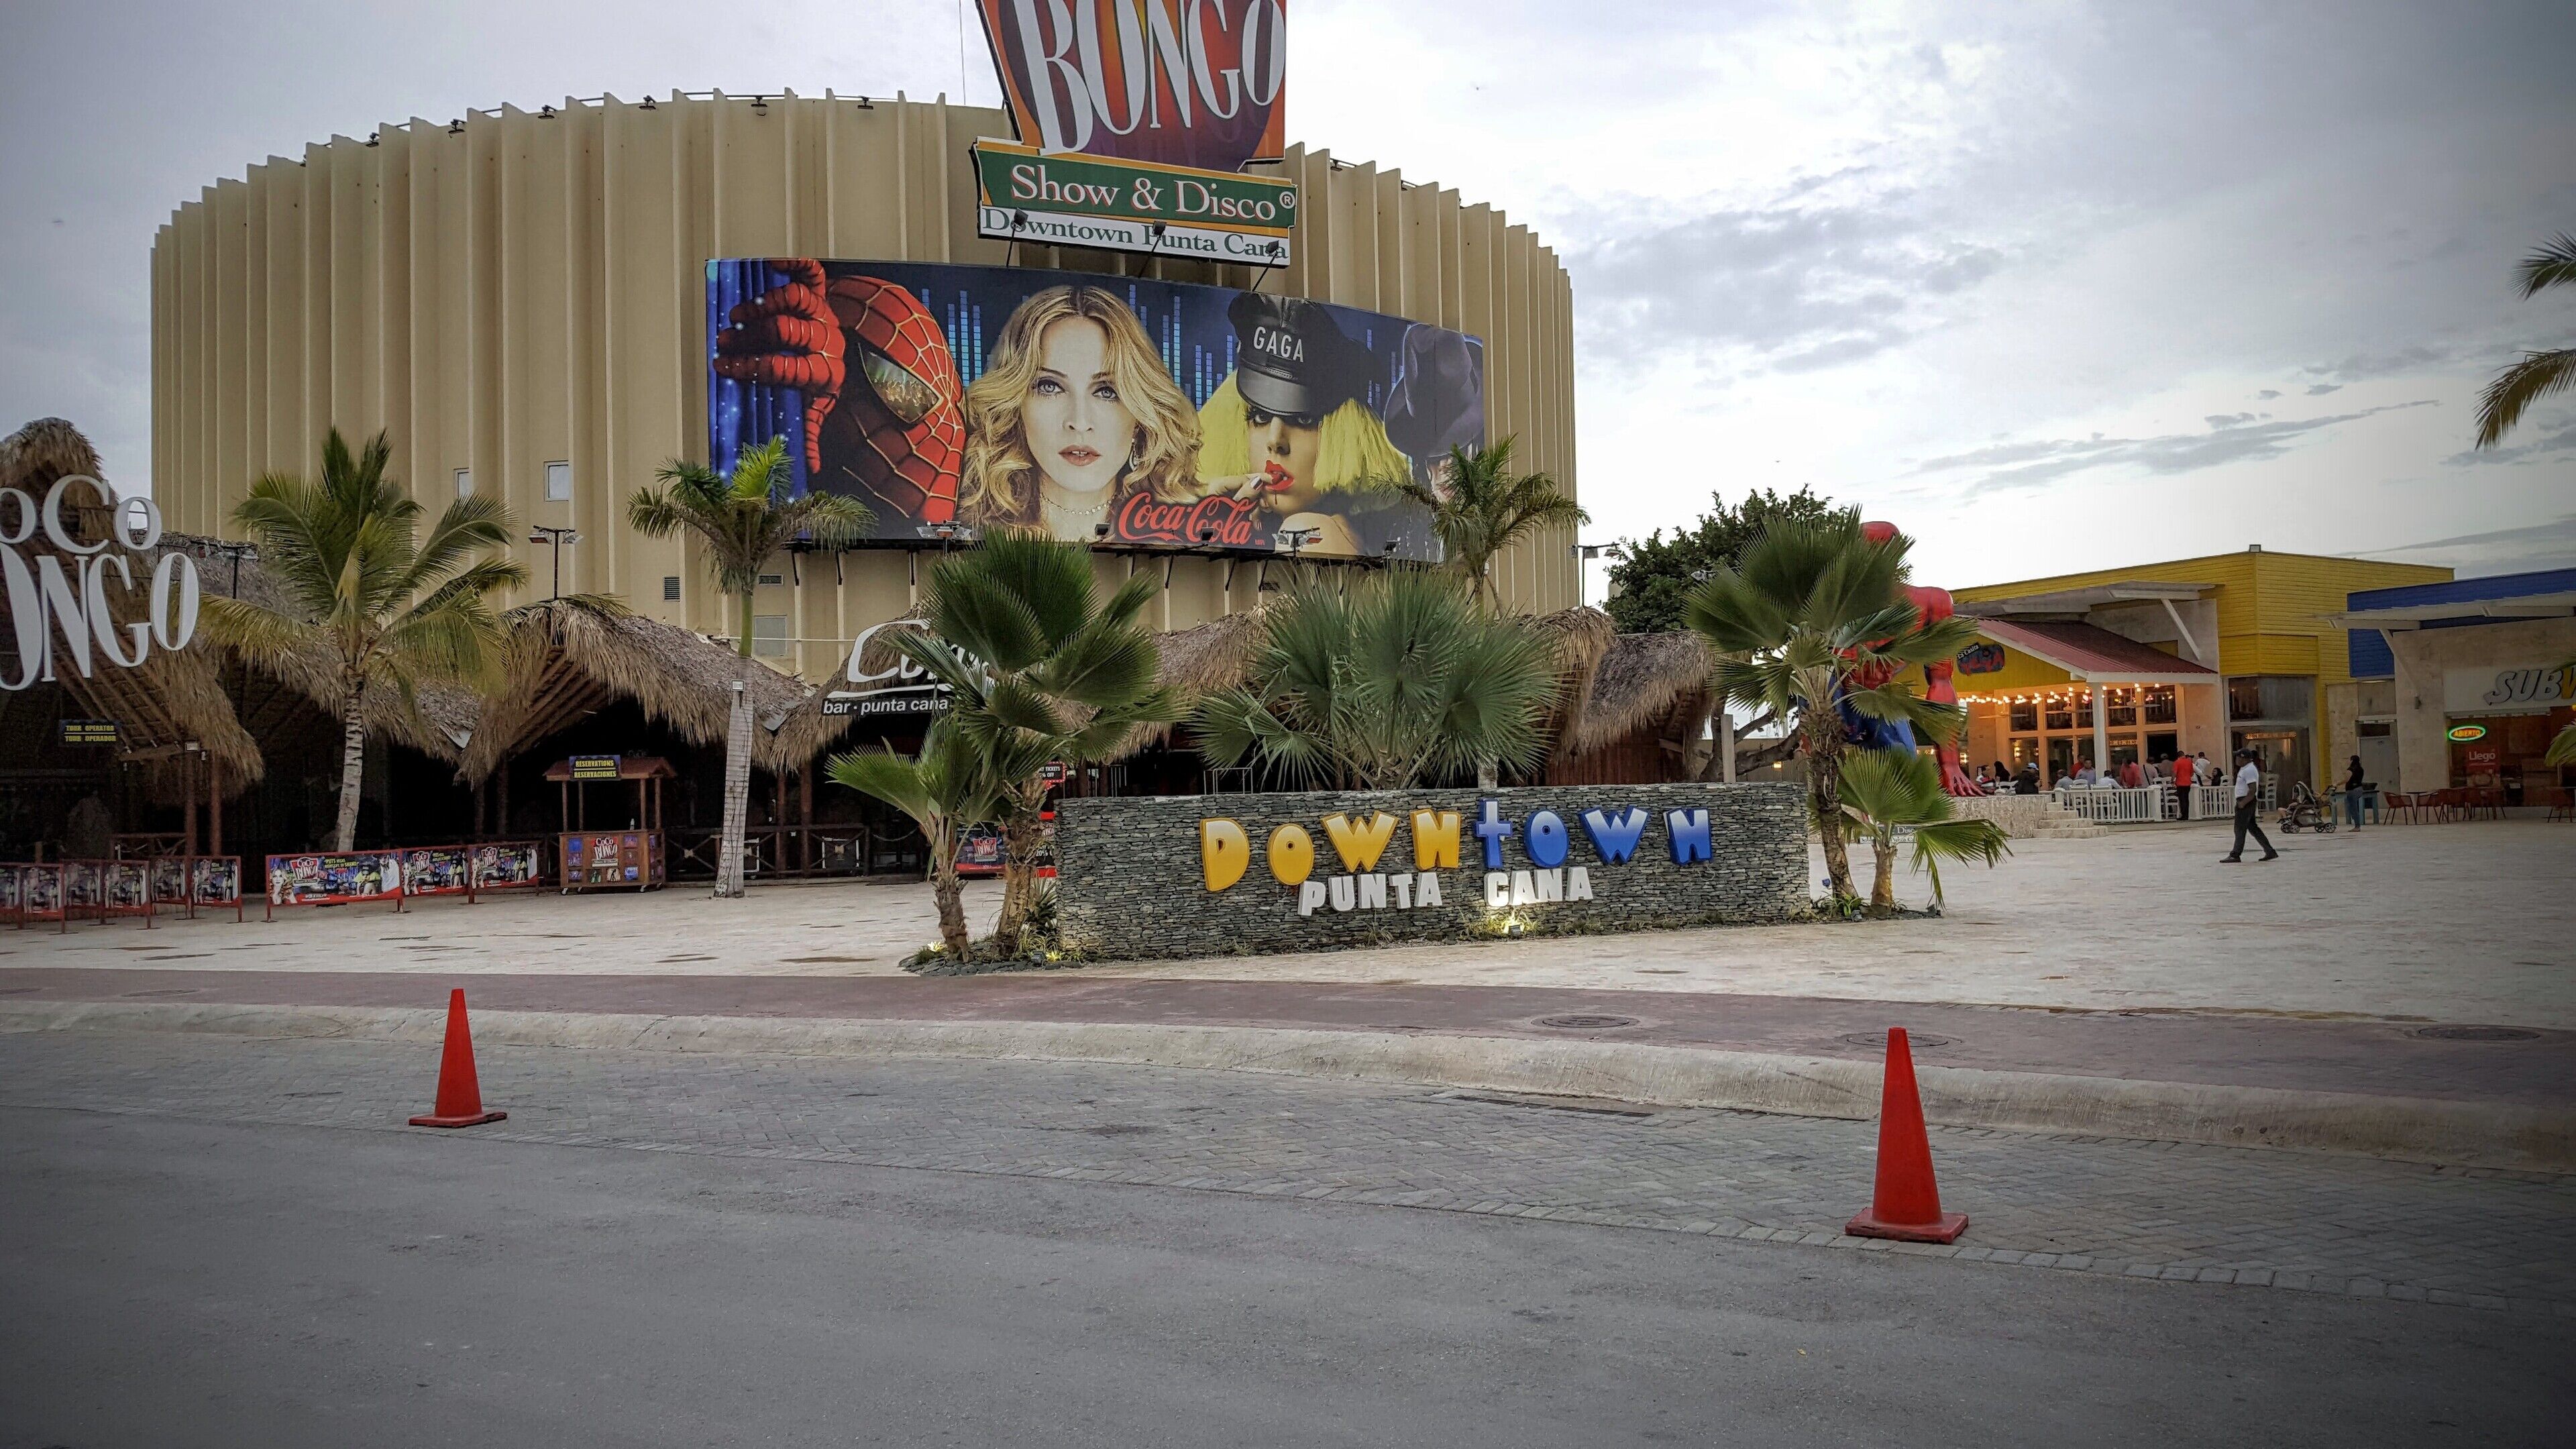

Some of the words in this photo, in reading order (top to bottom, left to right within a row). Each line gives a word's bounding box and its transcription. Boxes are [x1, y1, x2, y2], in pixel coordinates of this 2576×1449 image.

[1014, 0, 1284, 156] BONGO
[1012, 164, 1120, 207] Show
[1131, 178, 1164, 212] &
[1175, 180, 1276, 221] Disco
[982, 207, 1133, 244] Downtown
[1141, 224, 1218, 252] Punta
[1224, 233, 1289, 258] Cana
[1252, 326, 1304, 363] GAGA
[1119, 492, 1257, 545] Coca-Cola
[823, 701, 849, 714] bar
[861, 699, 906, 716] punta
[910, 699, 948, 711] cana
[2469, 749, 2496, 762] Llegó
[296, 865, 317, 880] BONGO
[594, 844, 618, 859] BONGO
[1297, 871, 1443, 917] PUNTA
[1483, 866, 1594, 908] CANA
